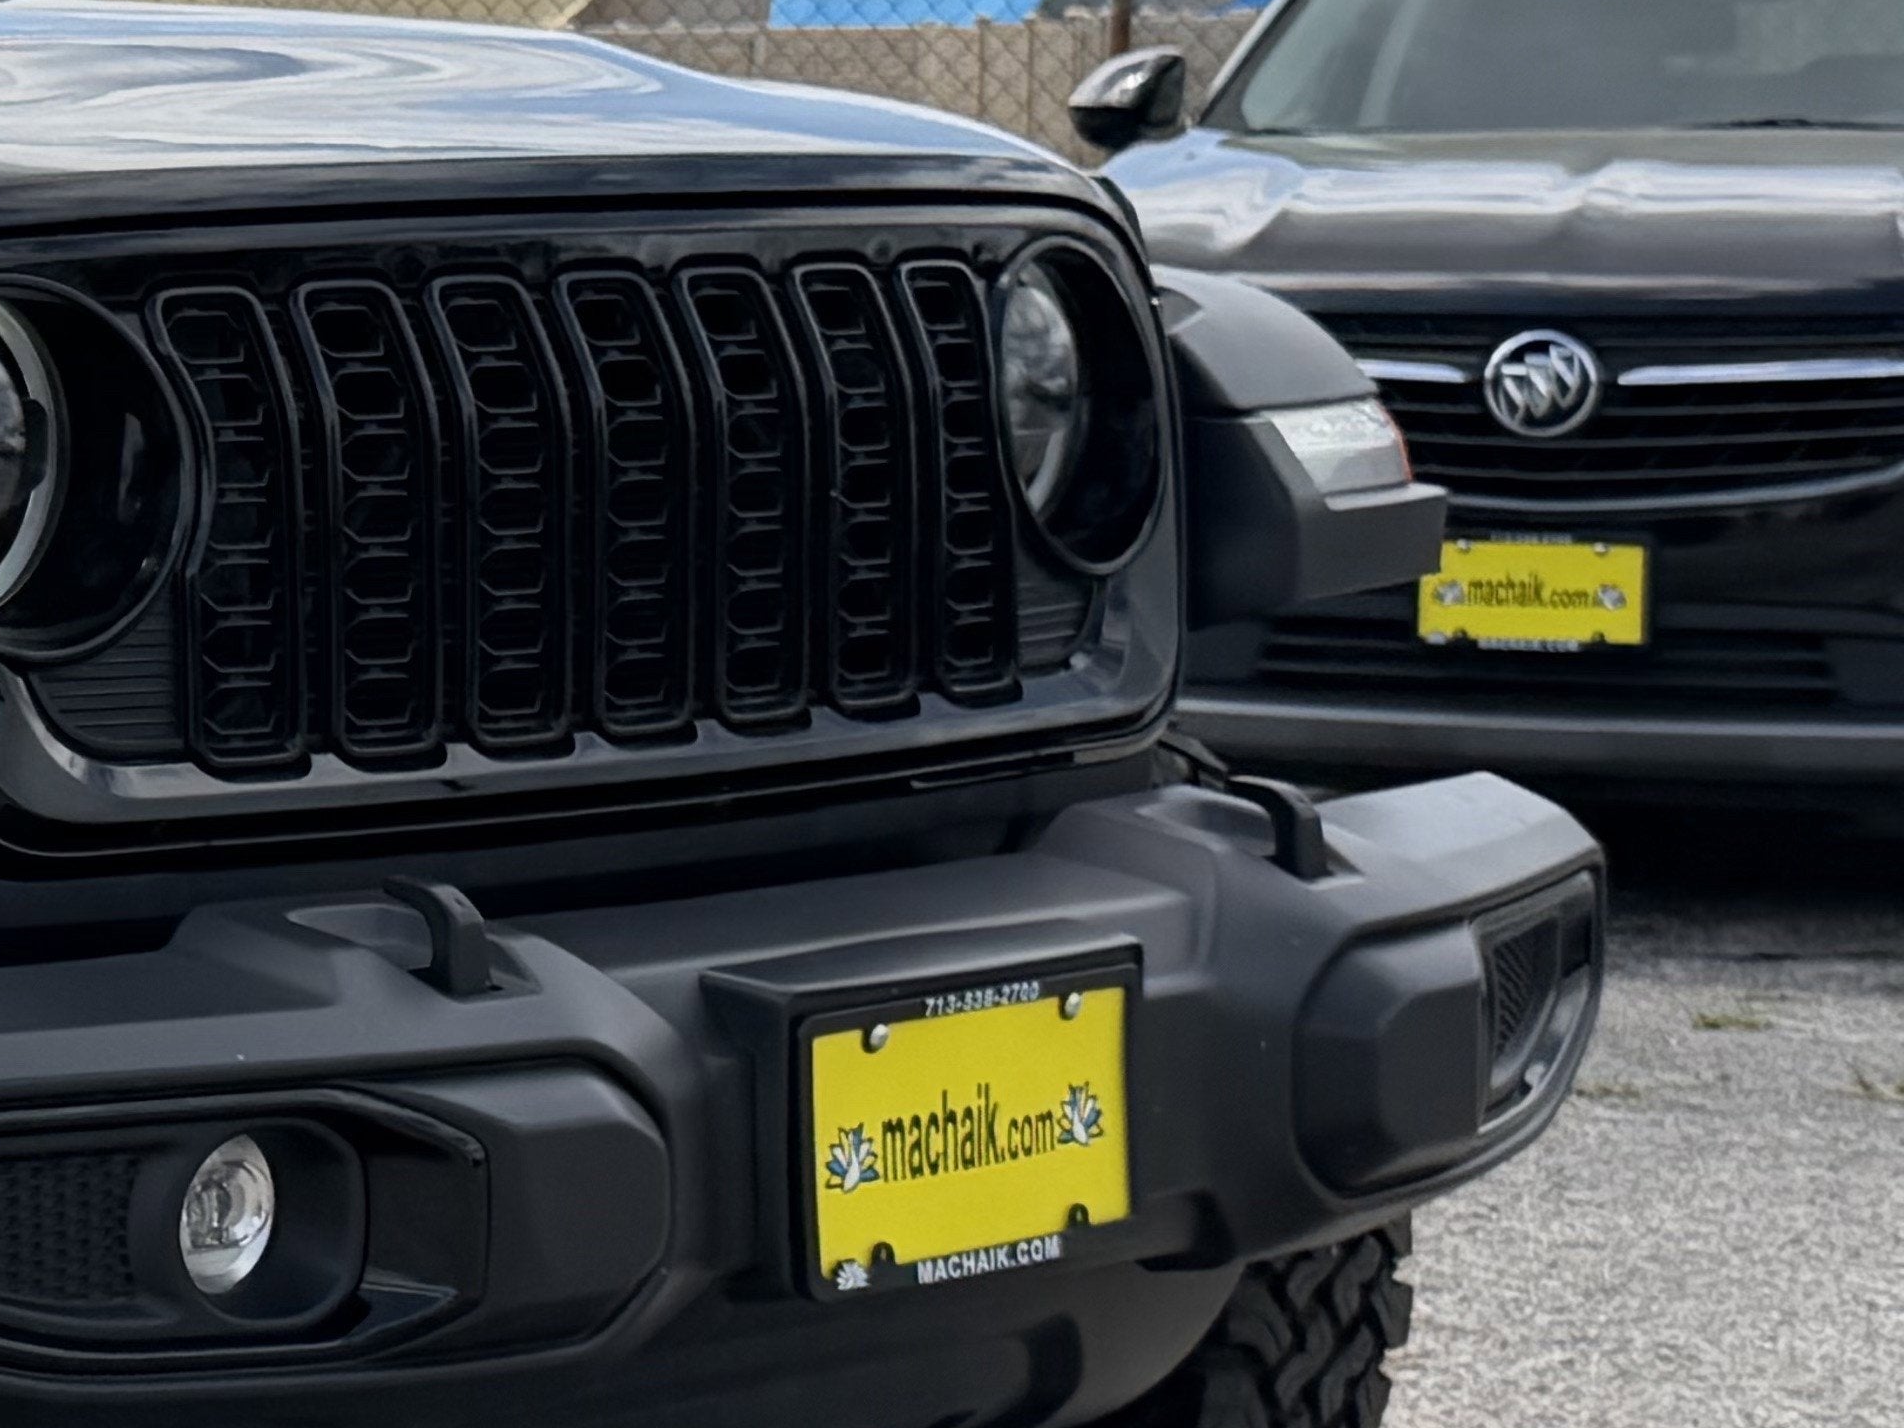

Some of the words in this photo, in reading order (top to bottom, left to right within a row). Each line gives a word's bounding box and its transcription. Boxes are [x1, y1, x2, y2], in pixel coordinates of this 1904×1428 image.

[1467, 573, 1590, 609] machaik.com
[880, 1083, 1056, 1184] machaik.com
[916, 1234, 1063, 1285] MACHAIK.COM
